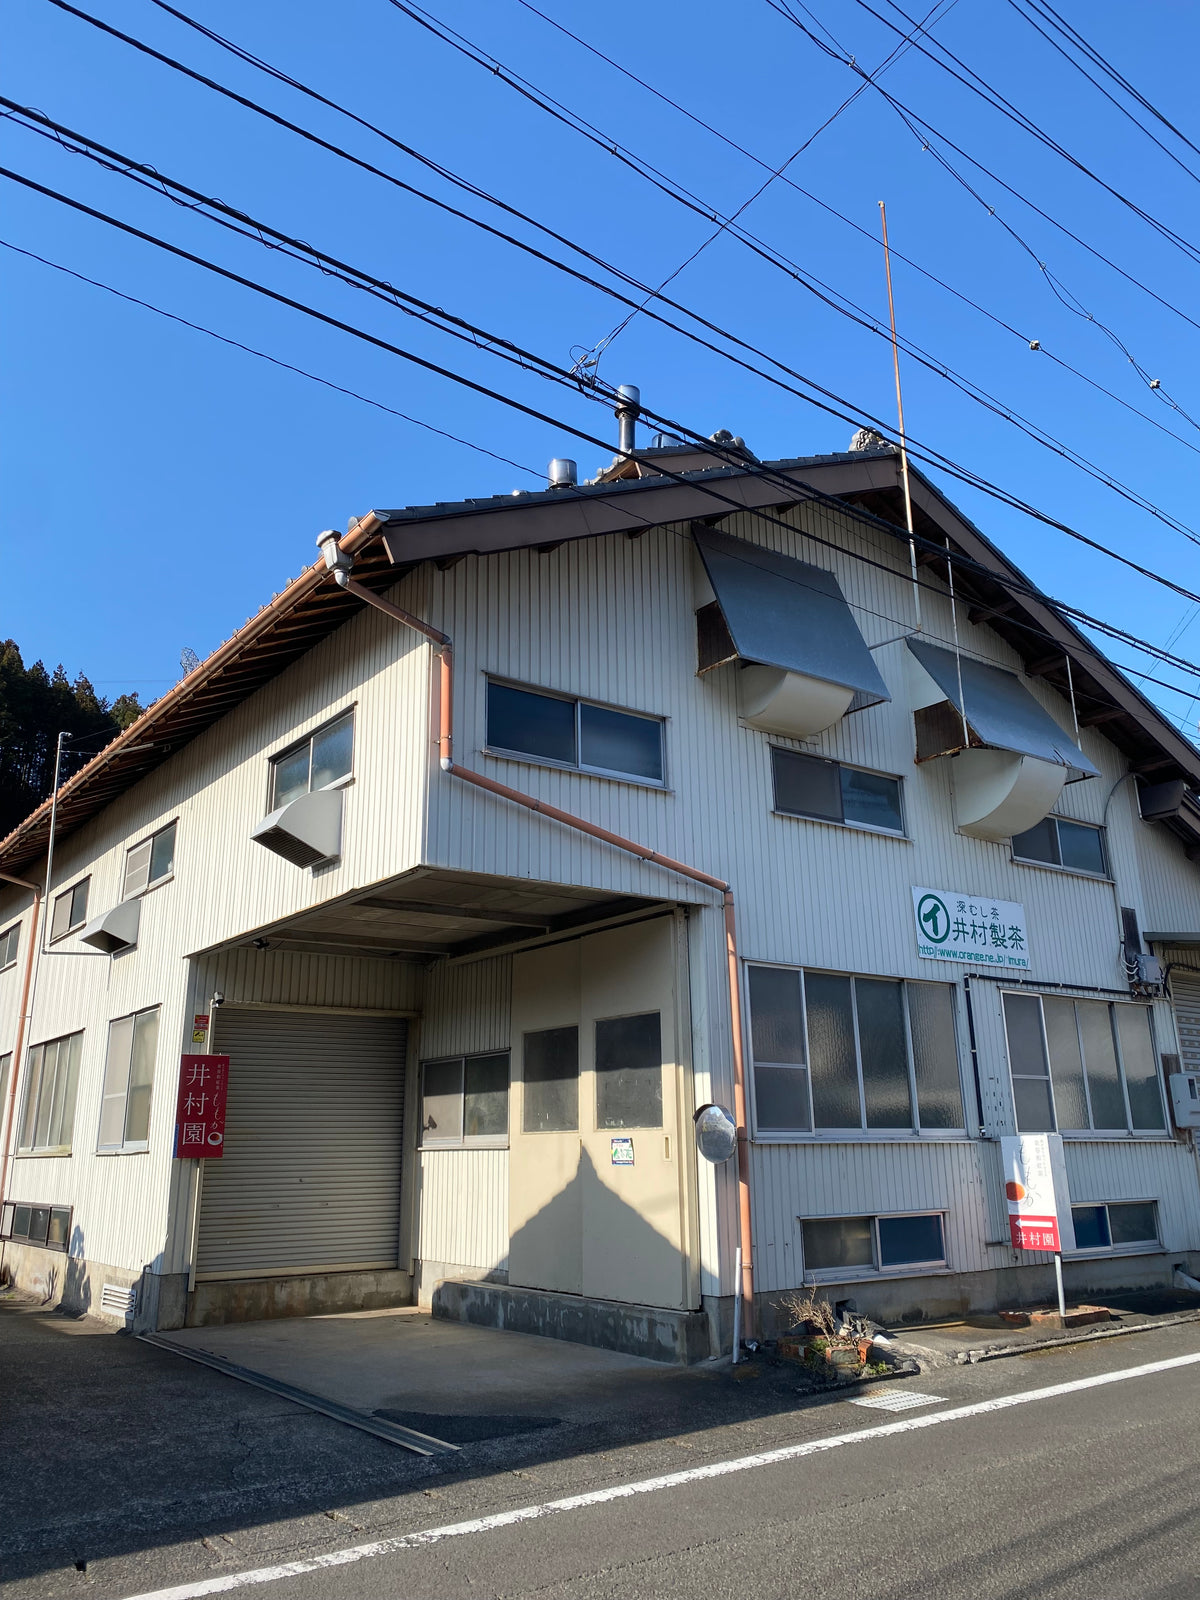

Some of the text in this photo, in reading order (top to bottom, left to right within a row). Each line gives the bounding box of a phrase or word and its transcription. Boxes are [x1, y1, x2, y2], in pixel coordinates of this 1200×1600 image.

[956, 900, 1000, 921] 深むし茶
[952, 917, 1025, 951] 井村製茶
[182, 1063, 211, 1145] 井村園
[1016, 1231, 1055, 1247] 井村園
